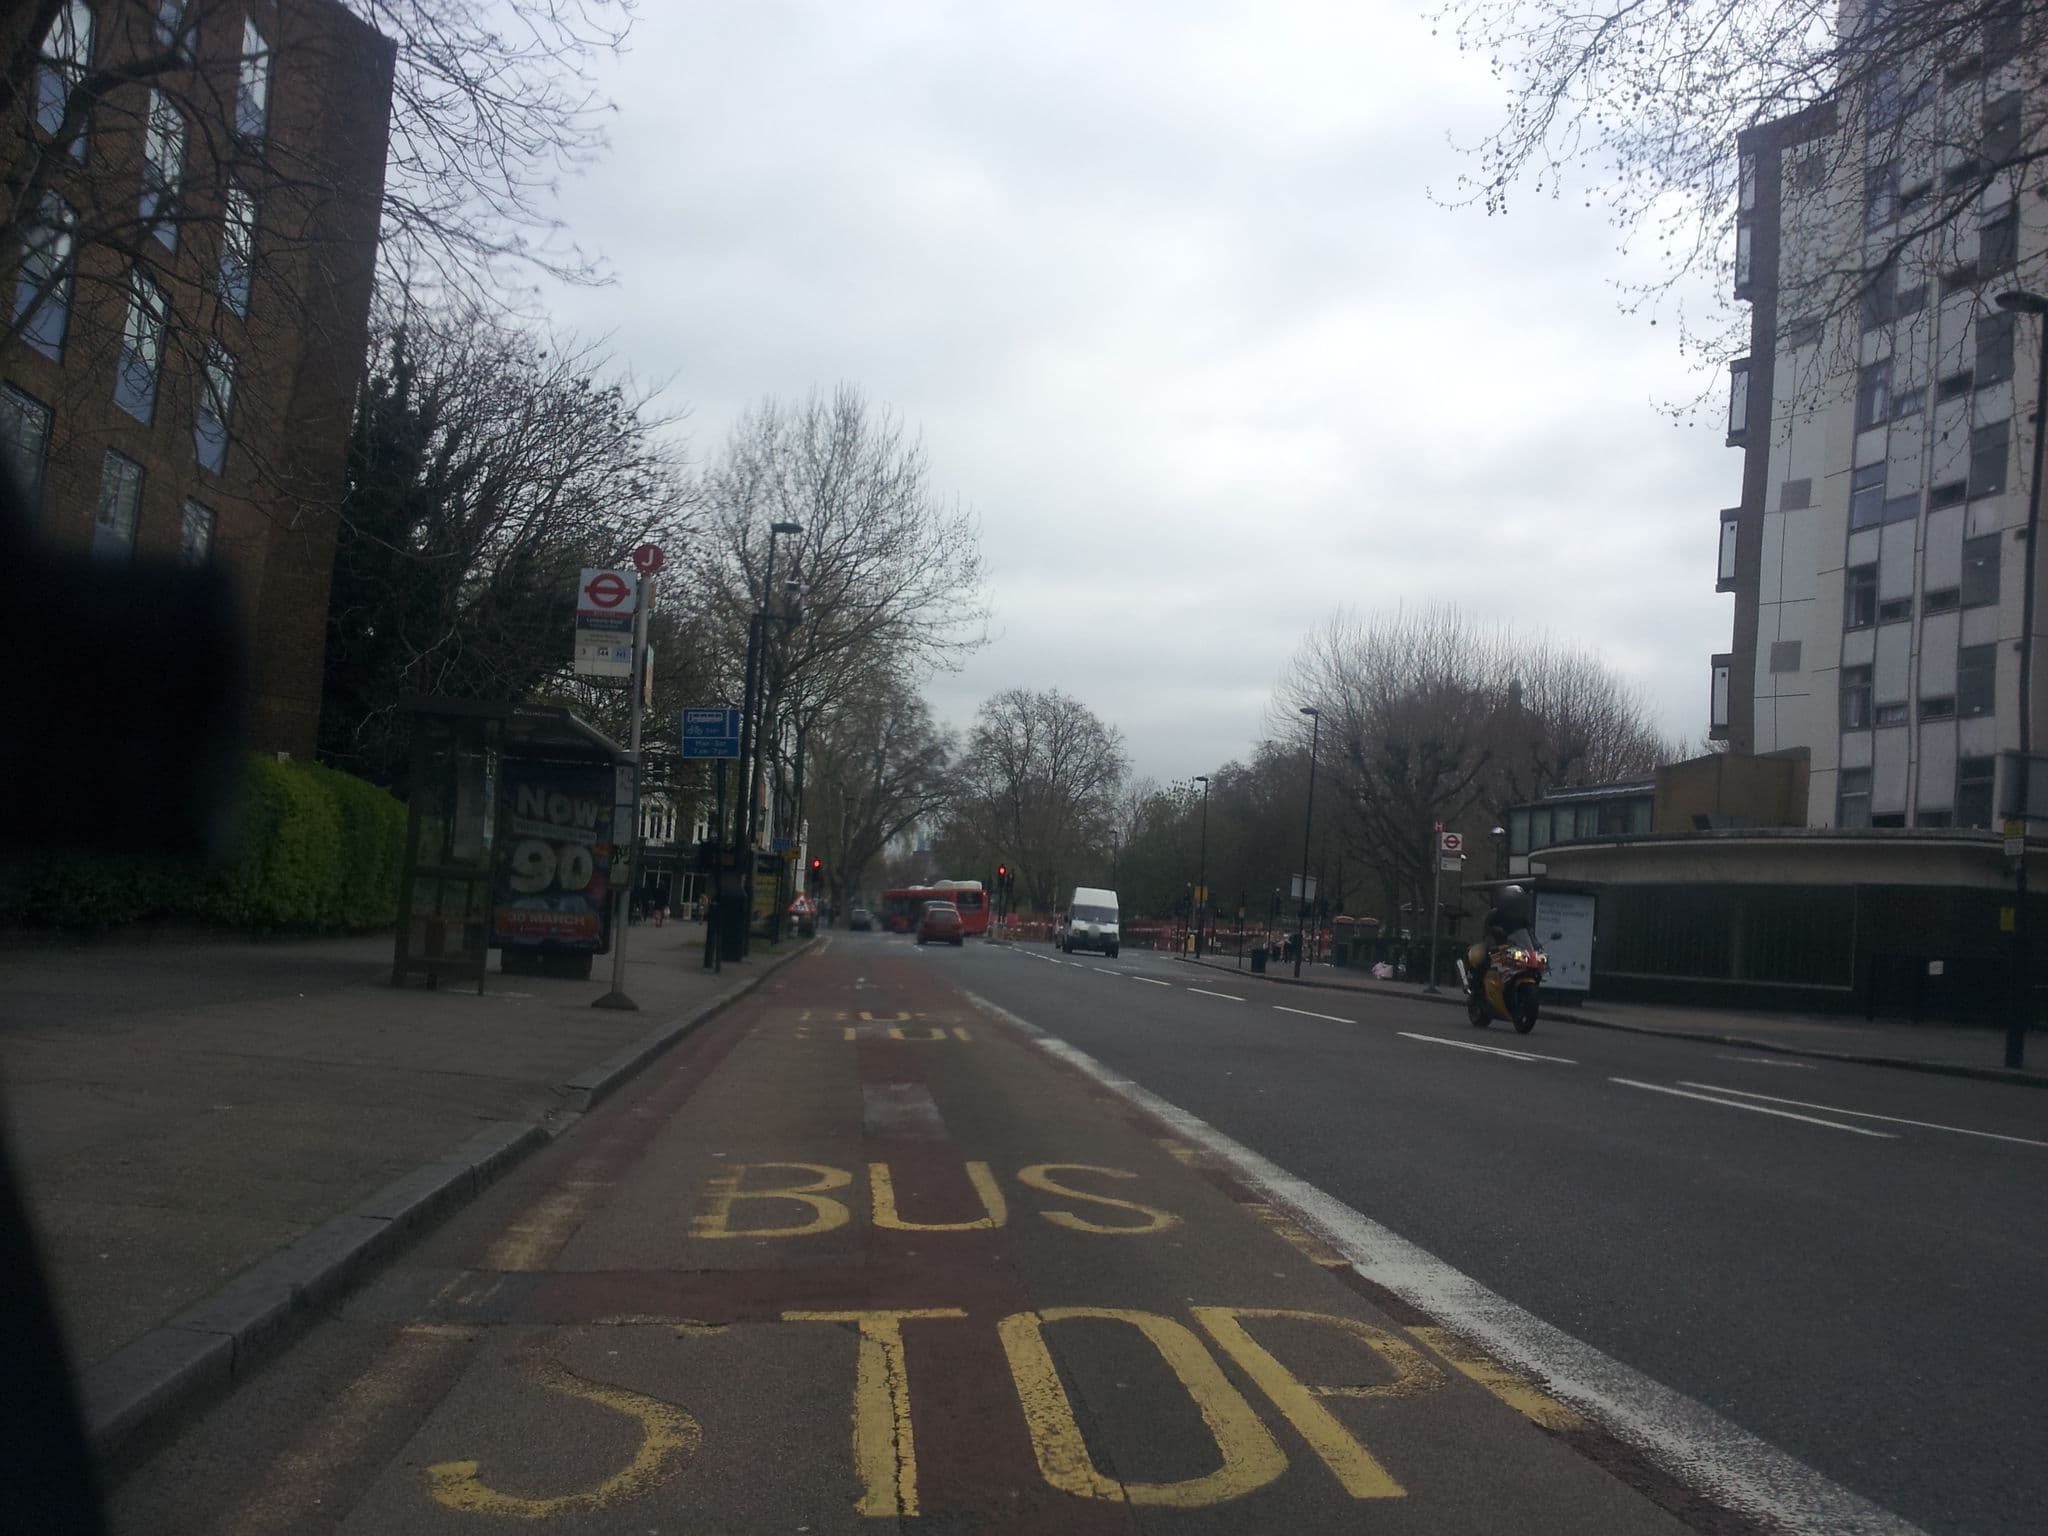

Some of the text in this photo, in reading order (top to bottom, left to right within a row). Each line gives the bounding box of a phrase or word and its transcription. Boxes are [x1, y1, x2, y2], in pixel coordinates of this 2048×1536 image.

[641, 548, 655, 567] J
[517, 783, 599, 828] NOW
[510, 839, 594, 893] 90
[688, 1161, 1182, 1240] BUS
[426, 1305, 1450, 1520] STOP
